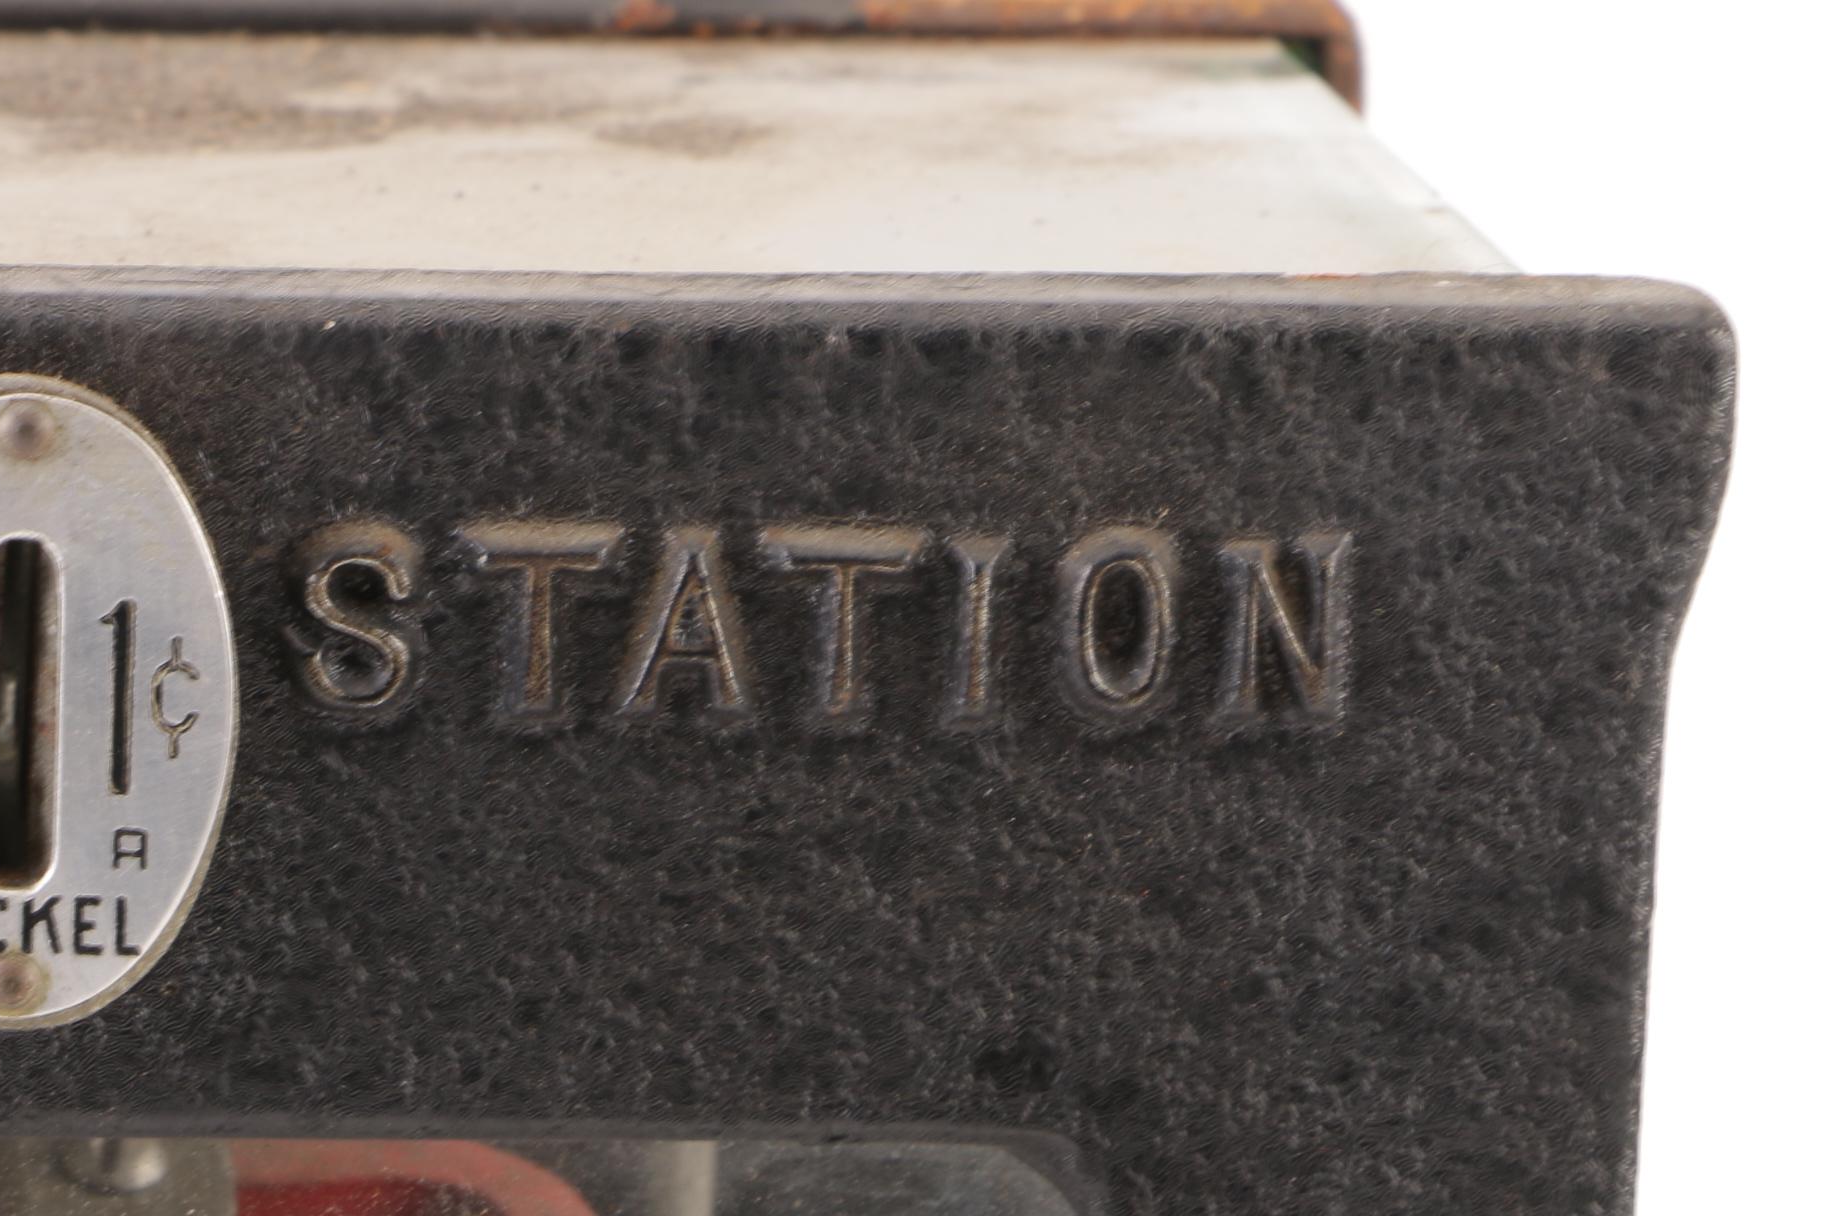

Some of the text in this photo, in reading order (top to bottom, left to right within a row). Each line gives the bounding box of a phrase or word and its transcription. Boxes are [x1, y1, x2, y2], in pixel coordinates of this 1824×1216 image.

[100, 598, 200, 796] 1¢
[290, 518, 1354, 730] STATION
[112, 828, 148, 869] A
